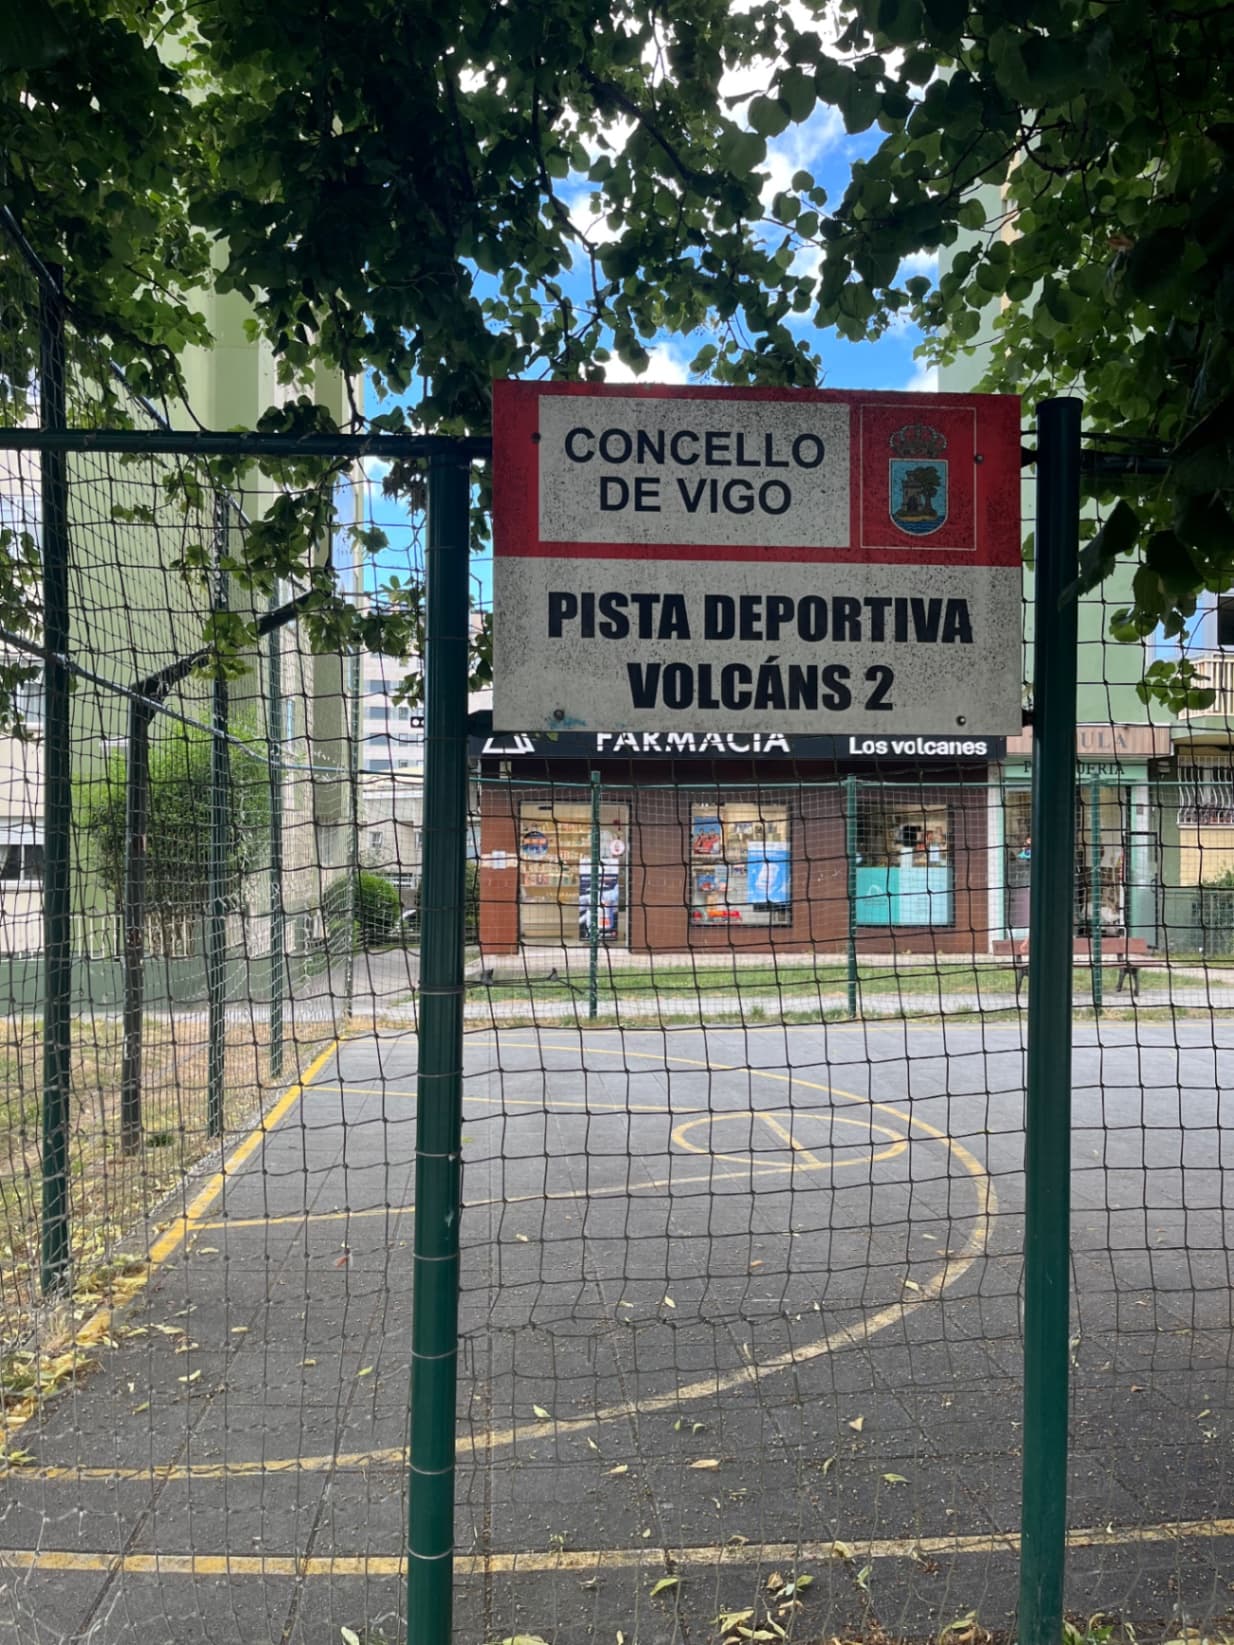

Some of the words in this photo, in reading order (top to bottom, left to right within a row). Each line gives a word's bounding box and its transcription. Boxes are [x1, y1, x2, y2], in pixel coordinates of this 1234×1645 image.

[565, 427, 825, 469] CONCELLO
[600, 476, 661, 512] DE
[676, 478, 792, 515] VIGO
[548, 591, 691, 640] PISTA
[704, 594, 974, 644] DEPORTIVA
[626, 655, 852, 711] VOLCÁNS
[864, 664, 895, 711] 2
[596, 732, 790, 753] FARMACIA
[849, 736, 888, 755] Los
[891, 737, 988, 756] volcanes
